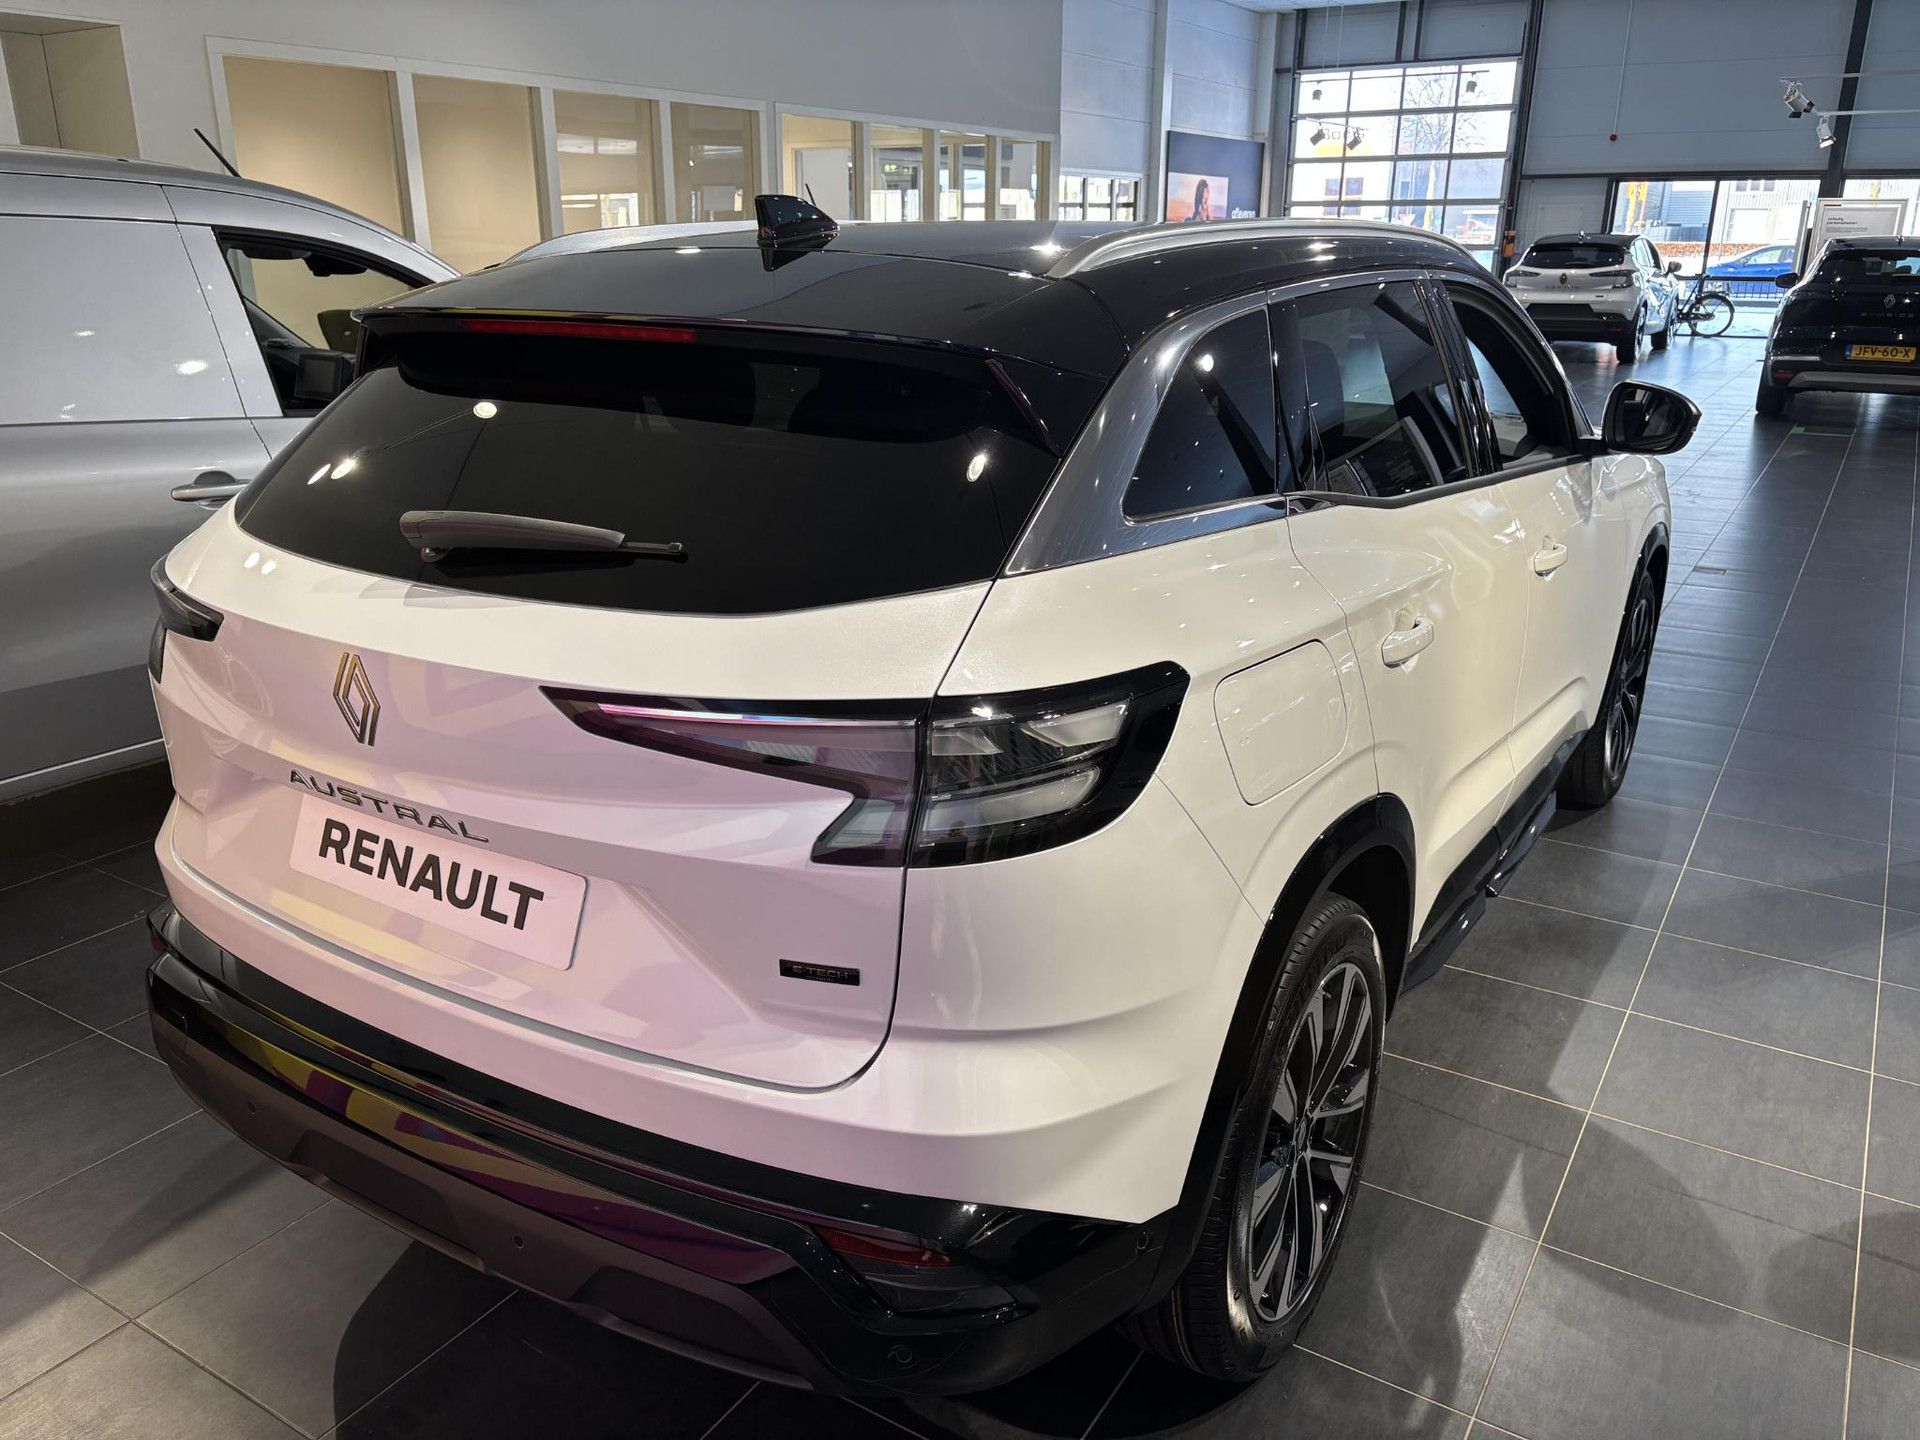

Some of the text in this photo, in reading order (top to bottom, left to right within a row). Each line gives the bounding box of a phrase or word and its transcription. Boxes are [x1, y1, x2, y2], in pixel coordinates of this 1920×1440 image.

[1855, 346, 1911, 358] JFV-60-X
[290, 769, 489, 843] AUSTRAL
[319, 818, 544, 930] RENAULT
[792, 965, 848, 979] E-TECH
